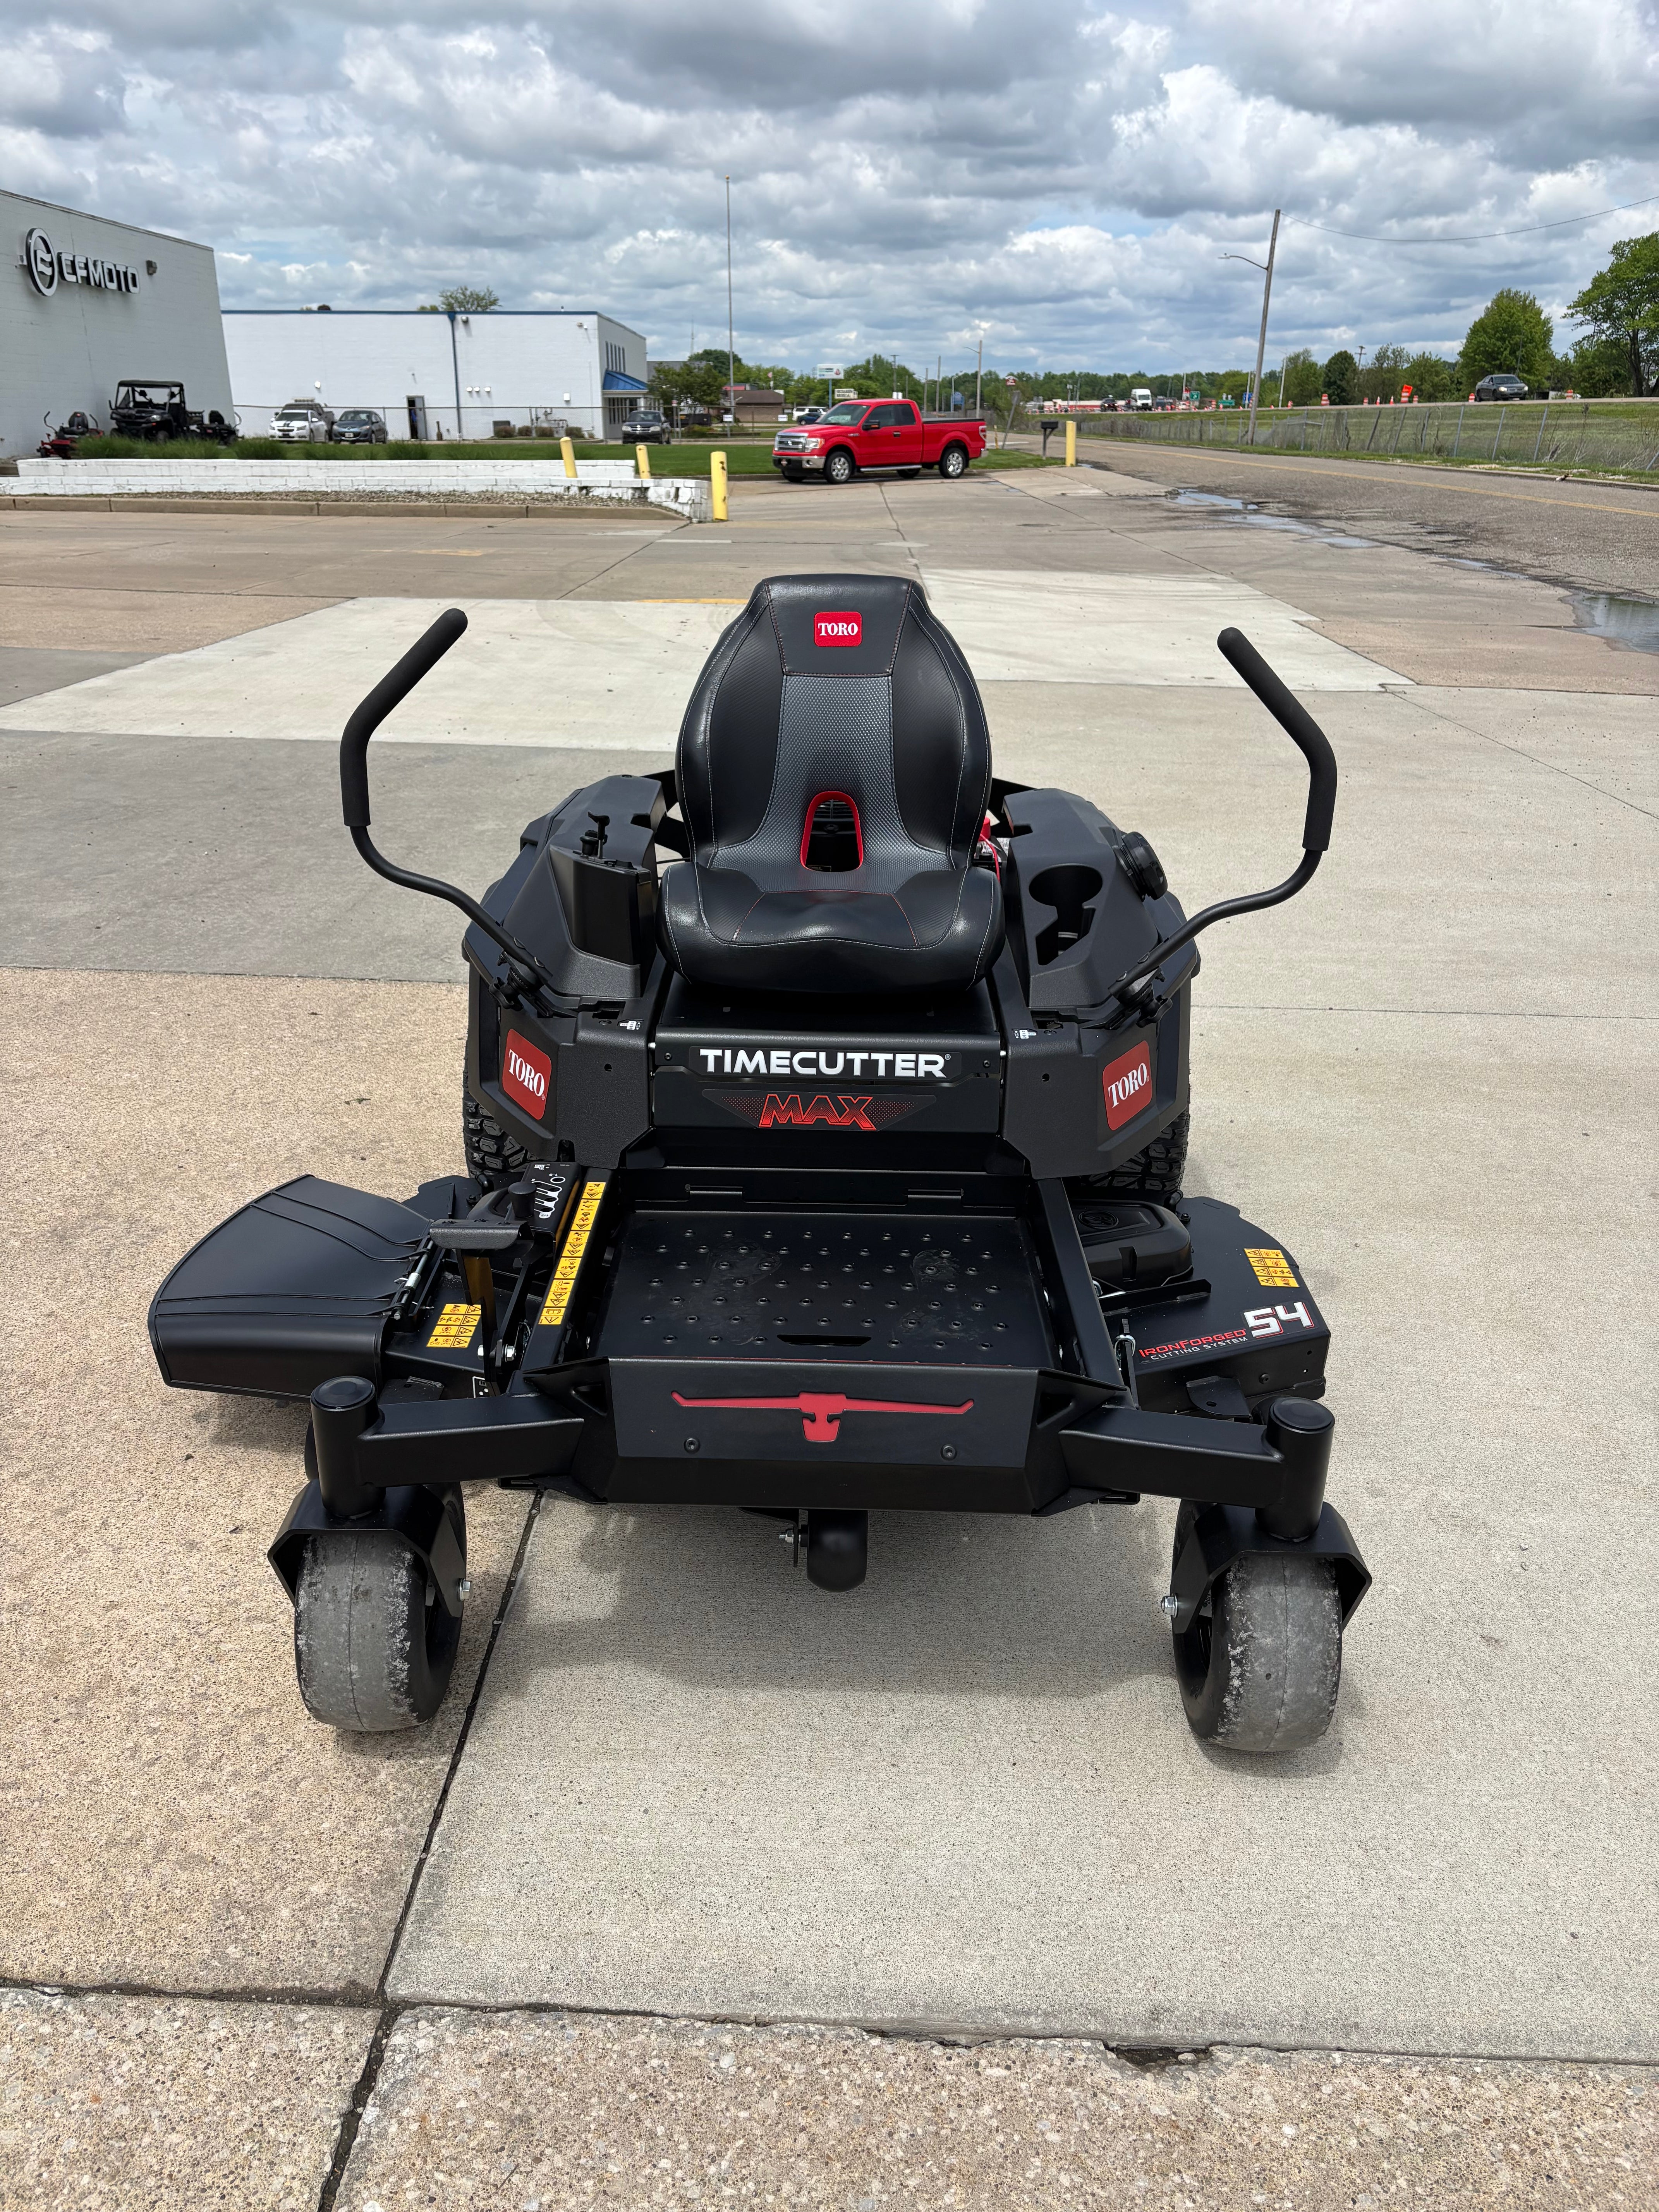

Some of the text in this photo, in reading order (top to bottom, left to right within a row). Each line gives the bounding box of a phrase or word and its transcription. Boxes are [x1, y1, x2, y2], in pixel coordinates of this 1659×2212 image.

[58, 252, 140, 293] CFMOTO
[818, 623, 858, 635] TORO
[508, 1049, 544, 1097] TORO
[700, 1049, 946, 1078] TIMECUTTER
[1108, 1063, 1147, 1108] TORO
[759, 1094, 876, 1130] MAX
[1243, 1302, 1315, 1338] 54
[1139, 1329, 1246, 1358] IRONFORGED
[1150, 1336, 1248, 1360] CUTTING SYSTEM
